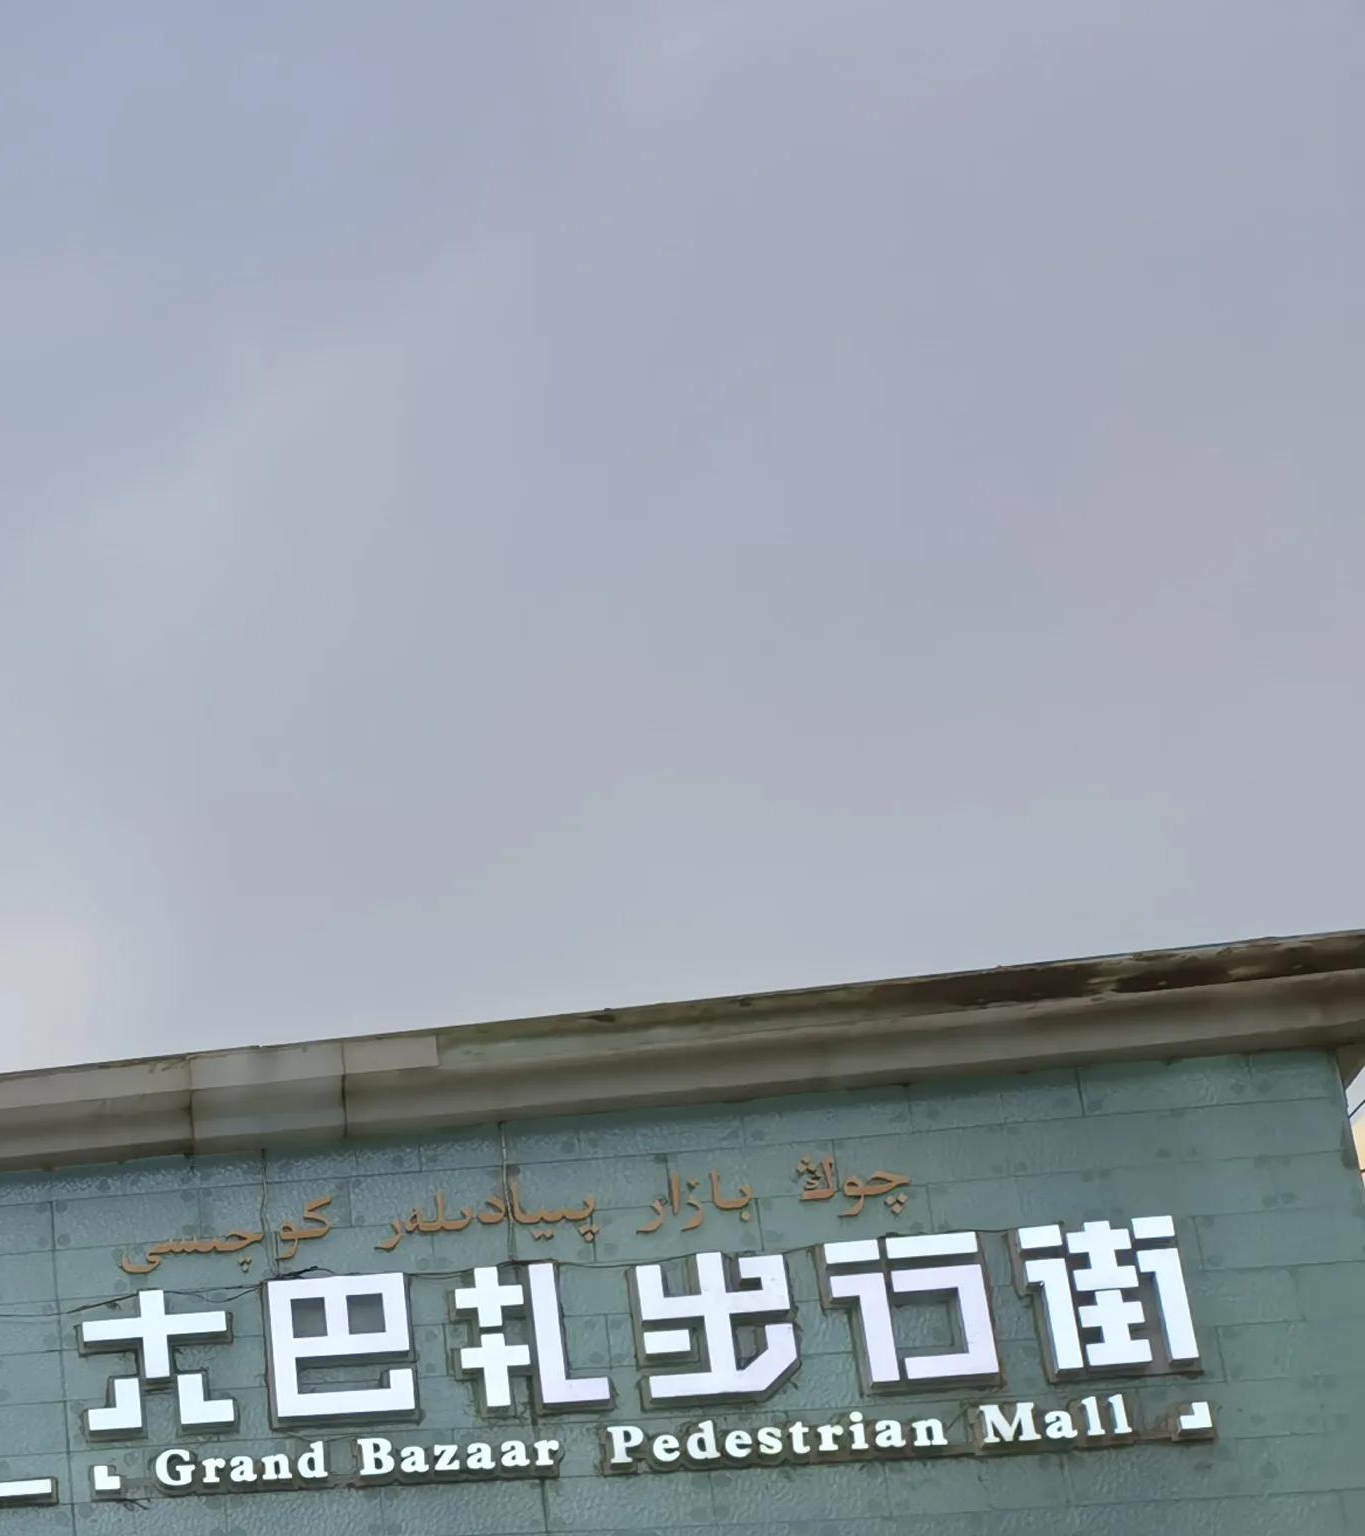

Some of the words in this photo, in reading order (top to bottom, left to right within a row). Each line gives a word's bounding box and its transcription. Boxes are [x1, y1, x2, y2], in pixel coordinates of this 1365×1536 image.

[636, 1169, 753, 1232] بازار
[80, 1215, 1200, 1432] 大巴扎步行街
[154, 1440, 328, 1487] Grand
[357, 1437, 559, 1475] Bazaar
[607, 1411, 948, 1463] Pedestrian
[979, 1394, 1132, 1443] Mall
